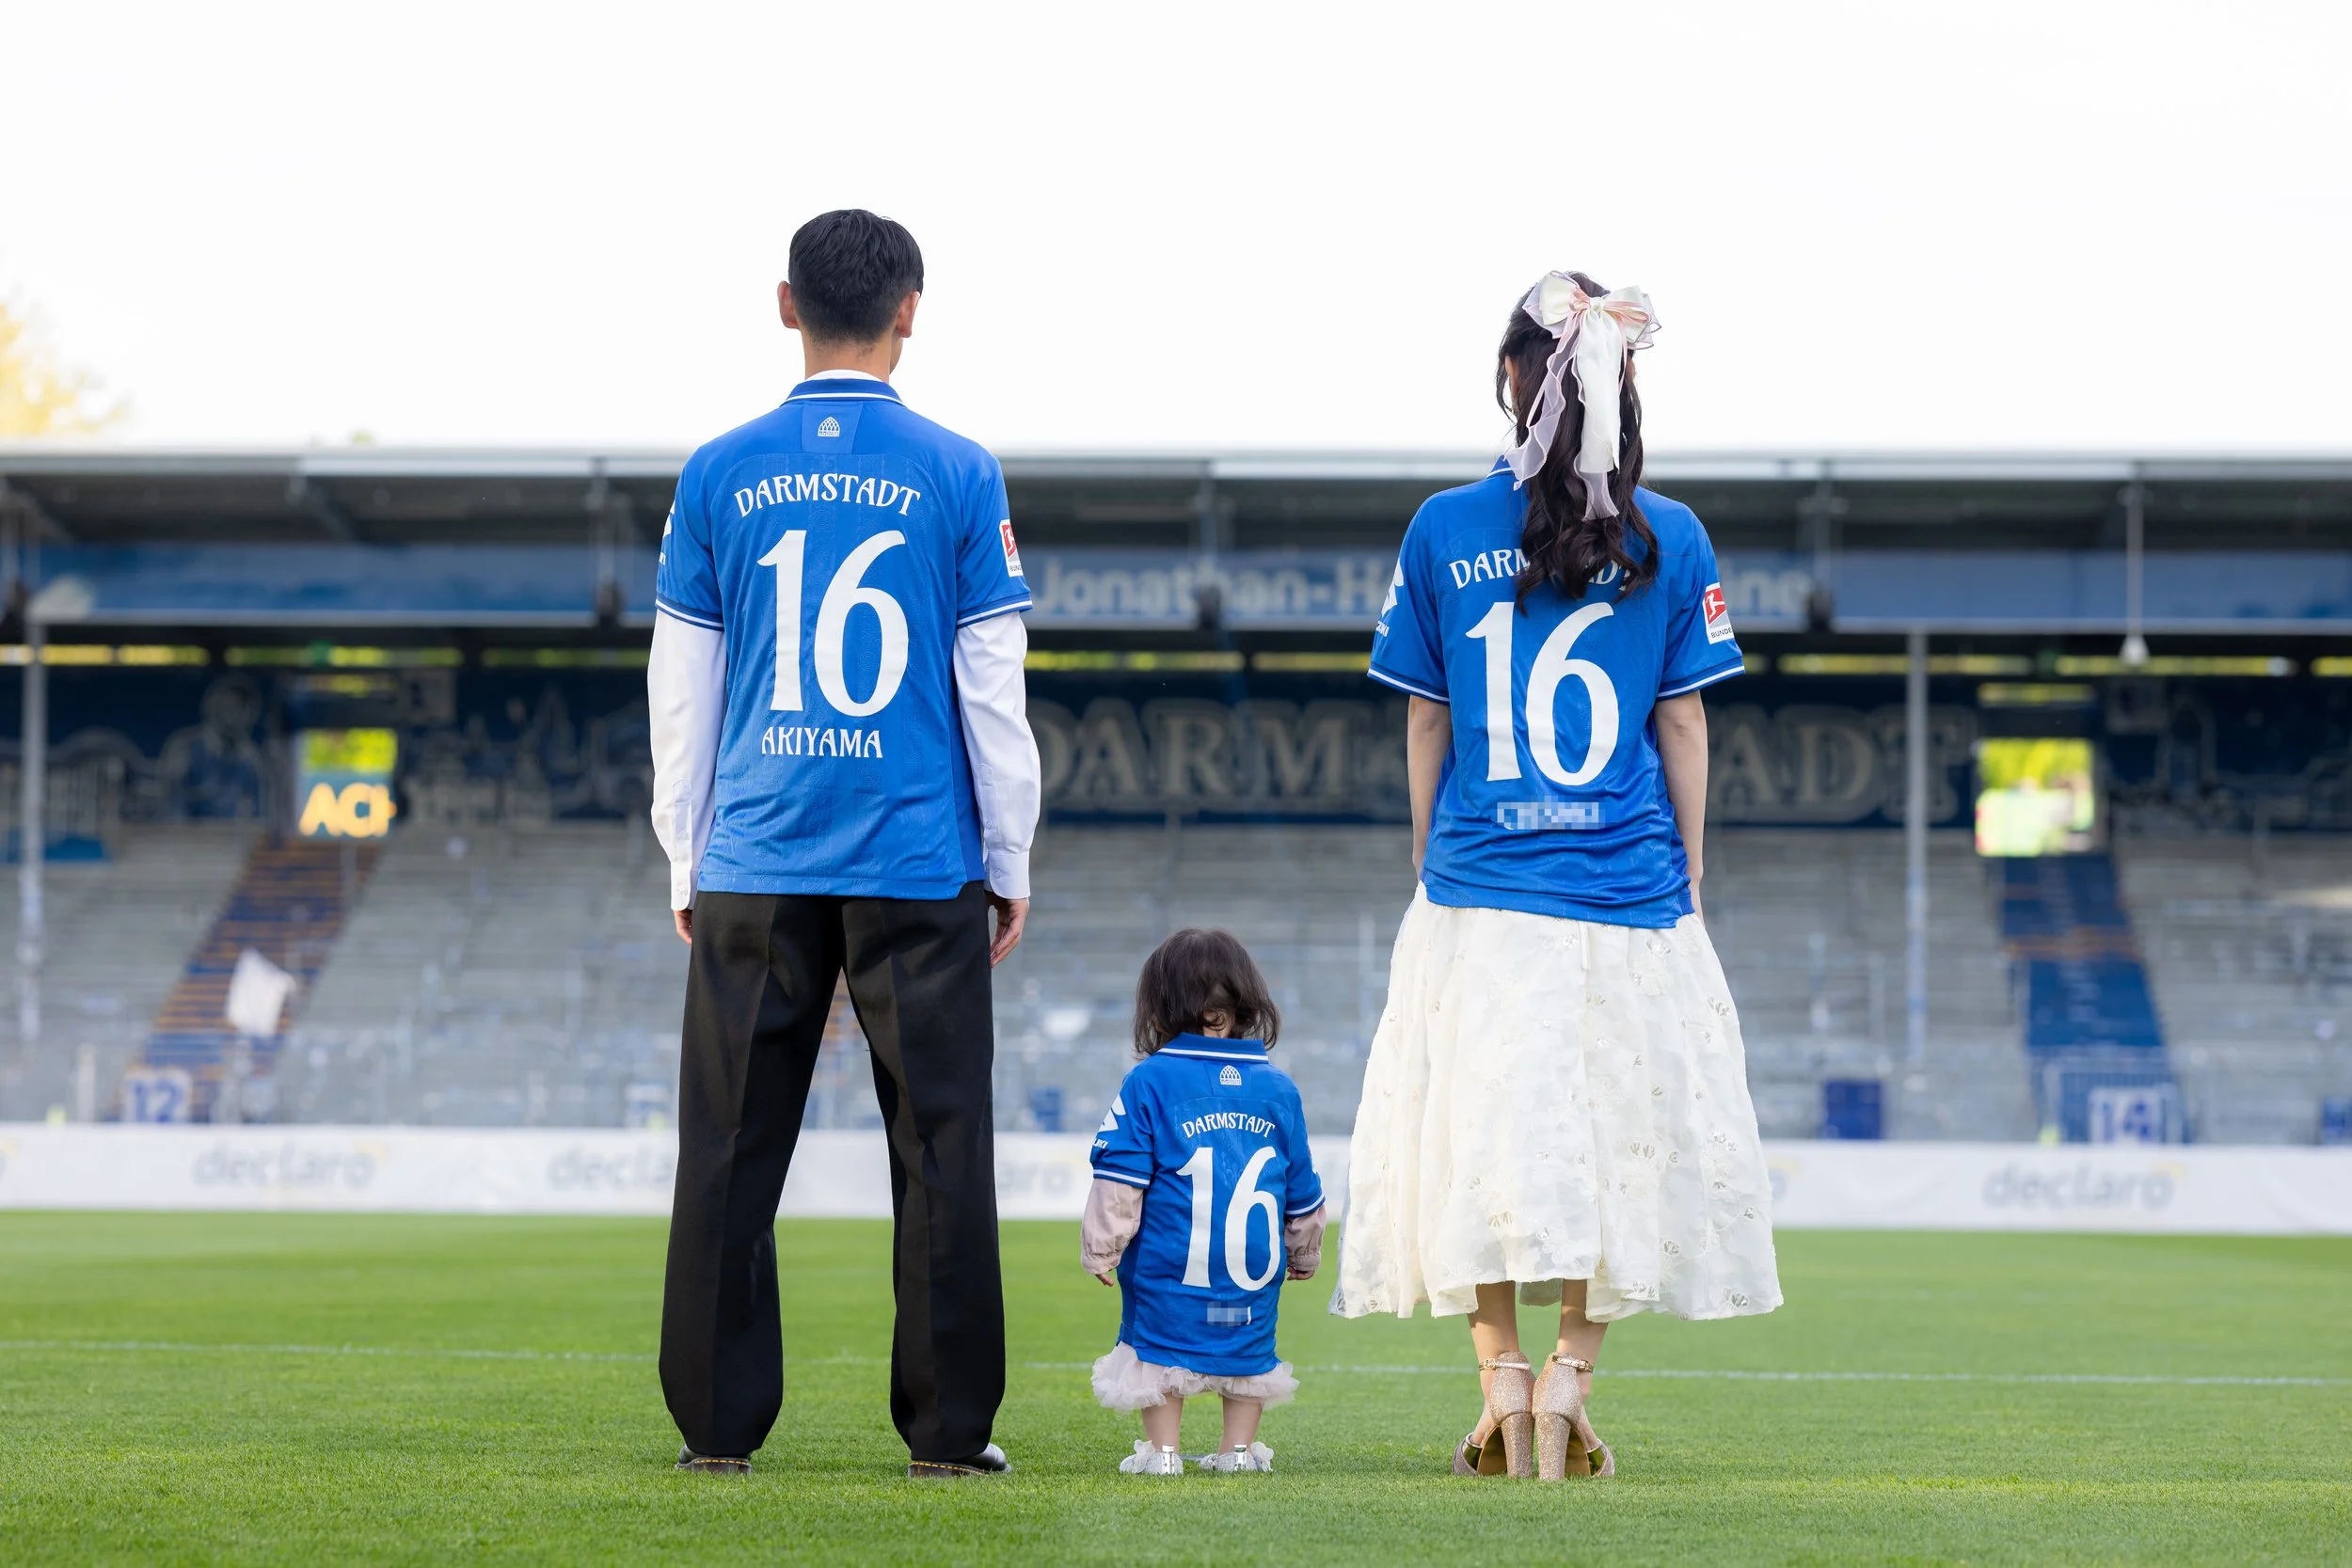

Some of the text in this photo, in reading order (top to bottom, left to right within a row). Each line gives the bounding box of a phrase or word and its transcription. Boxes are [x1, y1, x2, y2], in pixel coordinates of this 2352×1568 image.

[734, 472, 921, 517] DARMSTADT
[756, 530, 909, 717] 16
[1711, 627, 1733, 638] BUNDE
[1465, 601, 1619, 786] 16
[761, 726, 883, 758] AKIYAMA
[1182, 1112, 1276, 1138] DARMSTADT
[1176, 1146, 1280, 1291] 16
